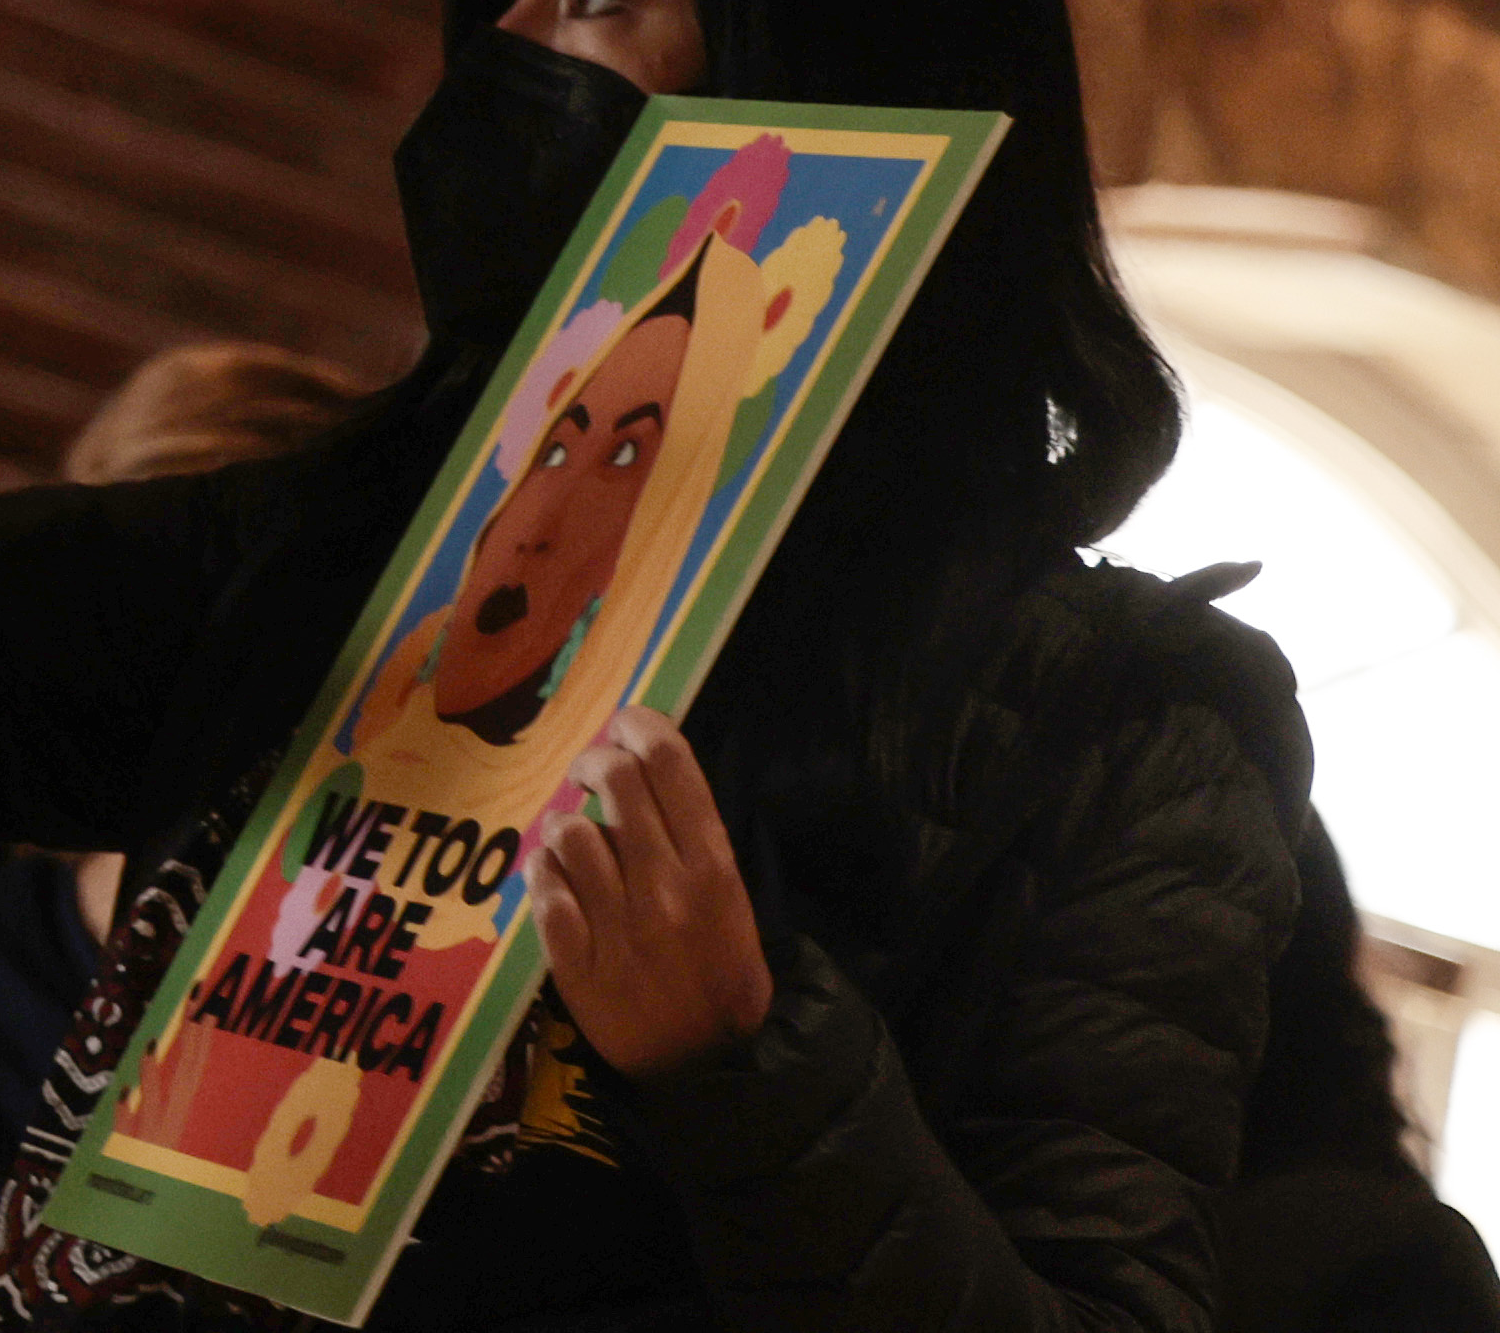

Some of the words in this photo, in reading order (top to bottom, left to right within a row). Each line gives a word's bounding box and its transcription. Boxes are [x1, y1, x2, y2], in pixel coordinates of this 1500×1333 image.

[303, 791, 409, 880] WE
[395, 811, 520, 907] TOO
[297, 886, 433, 981] ARE
[190, 953, 446, 1083] AMERICA
